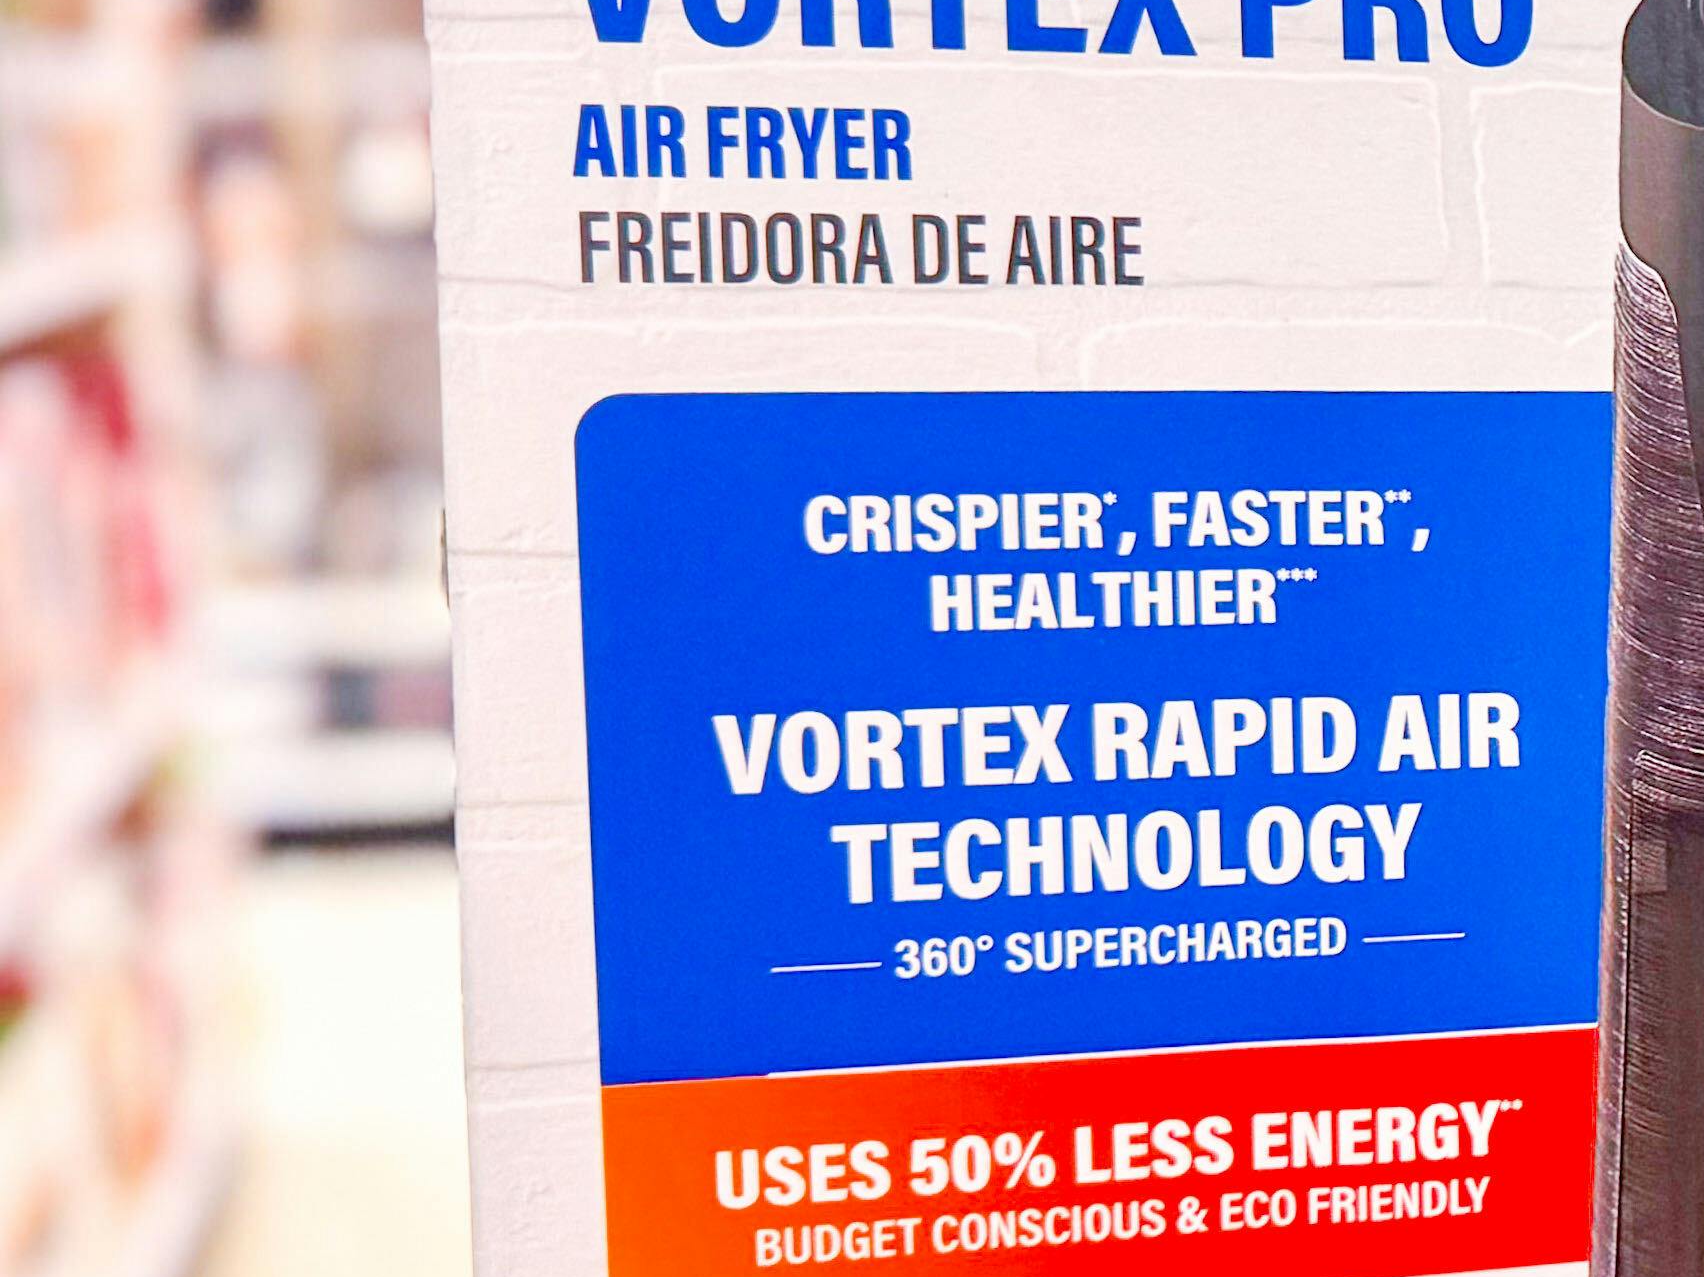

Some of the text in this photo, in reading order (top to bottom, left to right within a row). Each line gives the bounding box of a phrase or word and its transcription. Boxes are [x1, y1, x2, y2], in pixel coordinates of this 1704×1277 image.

[573, 104, 913, 182] AIR FRYER
[578, 210, 1144, 287] FREIDORA DE AIRE
[713, 691, 1520, 796] VORTEX RAPID AIR
[831, 803, 1422, 906] TECHNOLOGY
[893, 917, 1347, 981] 360° SUPERCHARGED
[715, 1137, 892, 1210] USES
[909, 1126, 1057, 1198] 50%
[1075, 1111, 1235, 1185] LESS
[755, 1176, 1491, 1268] BUDGET CONSCIOUS & ECO FRIENDLY
